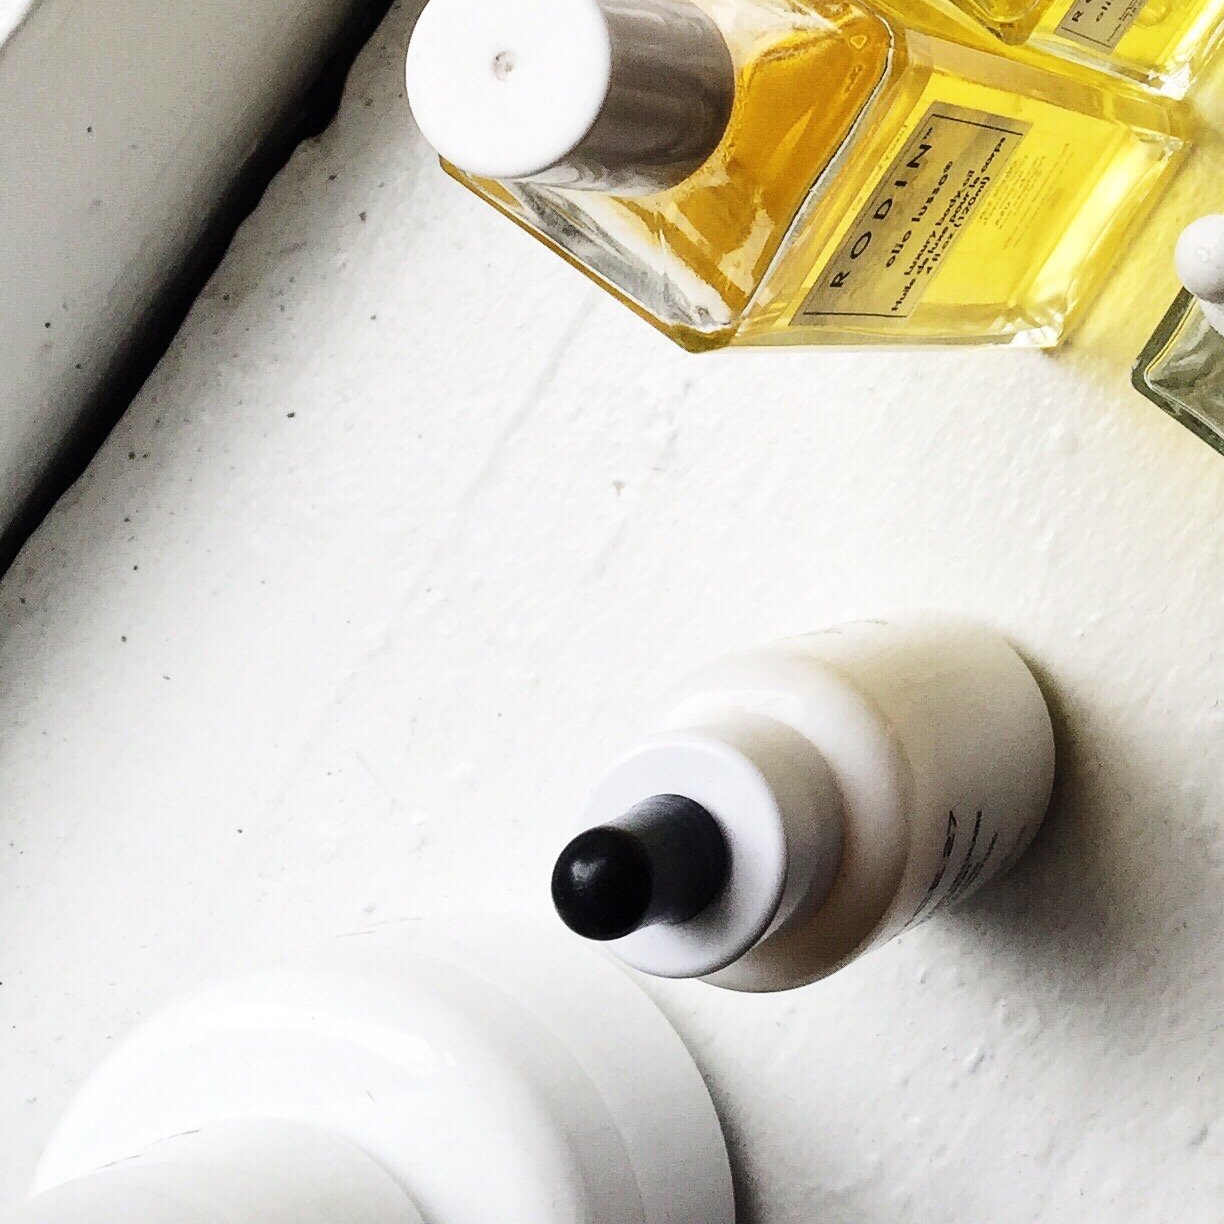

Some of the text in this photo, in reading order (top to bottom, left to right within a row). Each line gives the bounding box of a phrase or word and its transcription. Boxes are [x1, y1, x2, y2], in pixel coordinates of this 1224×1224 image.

[981, 137, 1006, 173] corps
[886, 230, 912, 268] olio
[904, 231, 936, 275] Luxury
[935, 189, 963, 226] body
